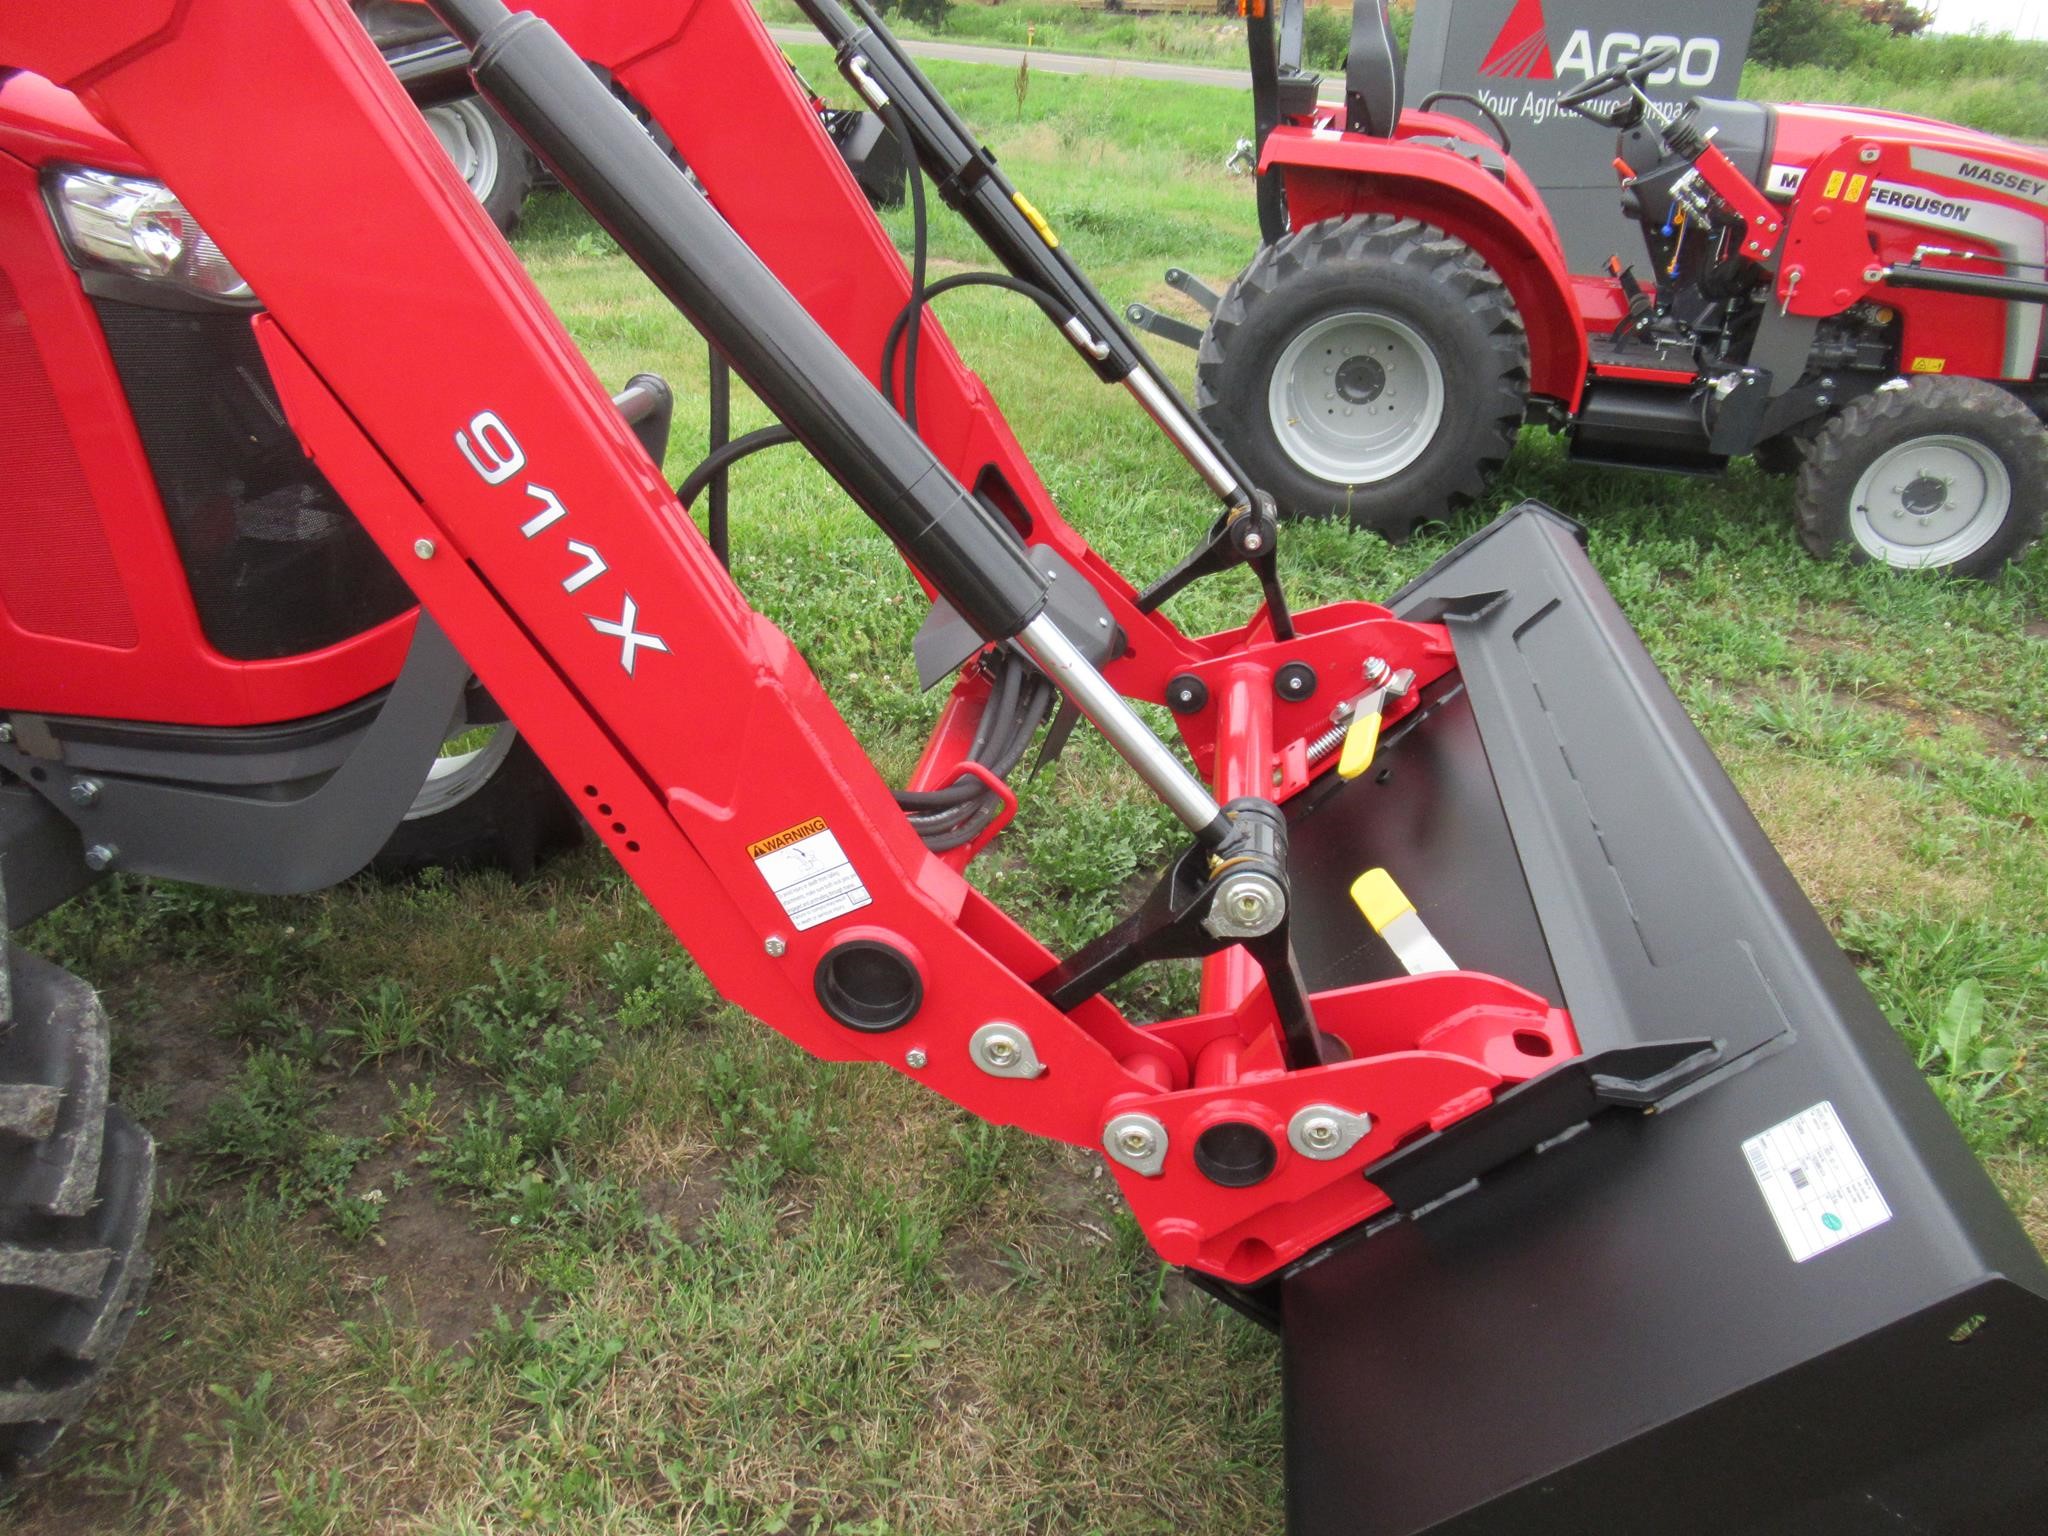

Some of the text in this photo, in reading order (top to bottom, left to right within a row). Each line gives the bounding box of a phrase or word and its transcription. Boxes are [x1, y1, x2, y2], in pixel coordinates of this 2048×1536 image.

[1556, 29, 1720, 87] AGCO
[1478, 89, 1518, 116] Your
[1958, 163, 2046, 196] MASSEY
[1868, 187, 1971, 222] FERGUSON
[454, 409, 674, 680] 911X
[763, 819, 826, 852] WARNING
